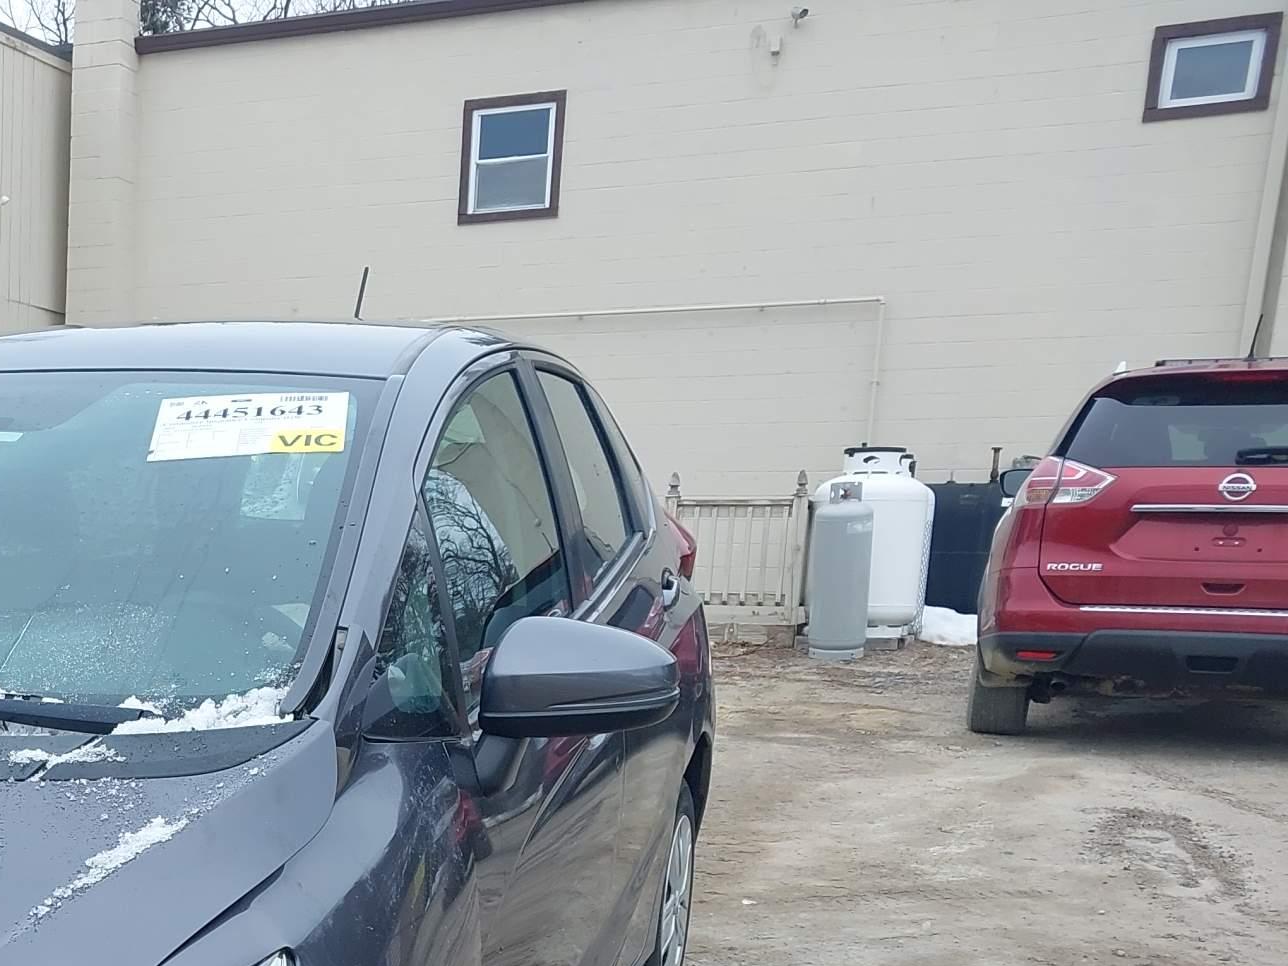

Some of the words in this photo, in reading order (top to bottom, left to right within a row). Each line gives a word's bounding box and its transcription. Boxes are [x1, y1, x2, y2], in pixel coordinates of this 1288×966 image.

[176, 404, 324, 421] 44451643
[278, 434, 338, 447] VIC
[1222, 484, 1254, 492] NISSAN
[1046, 563, 1103, 572] ROGUE
